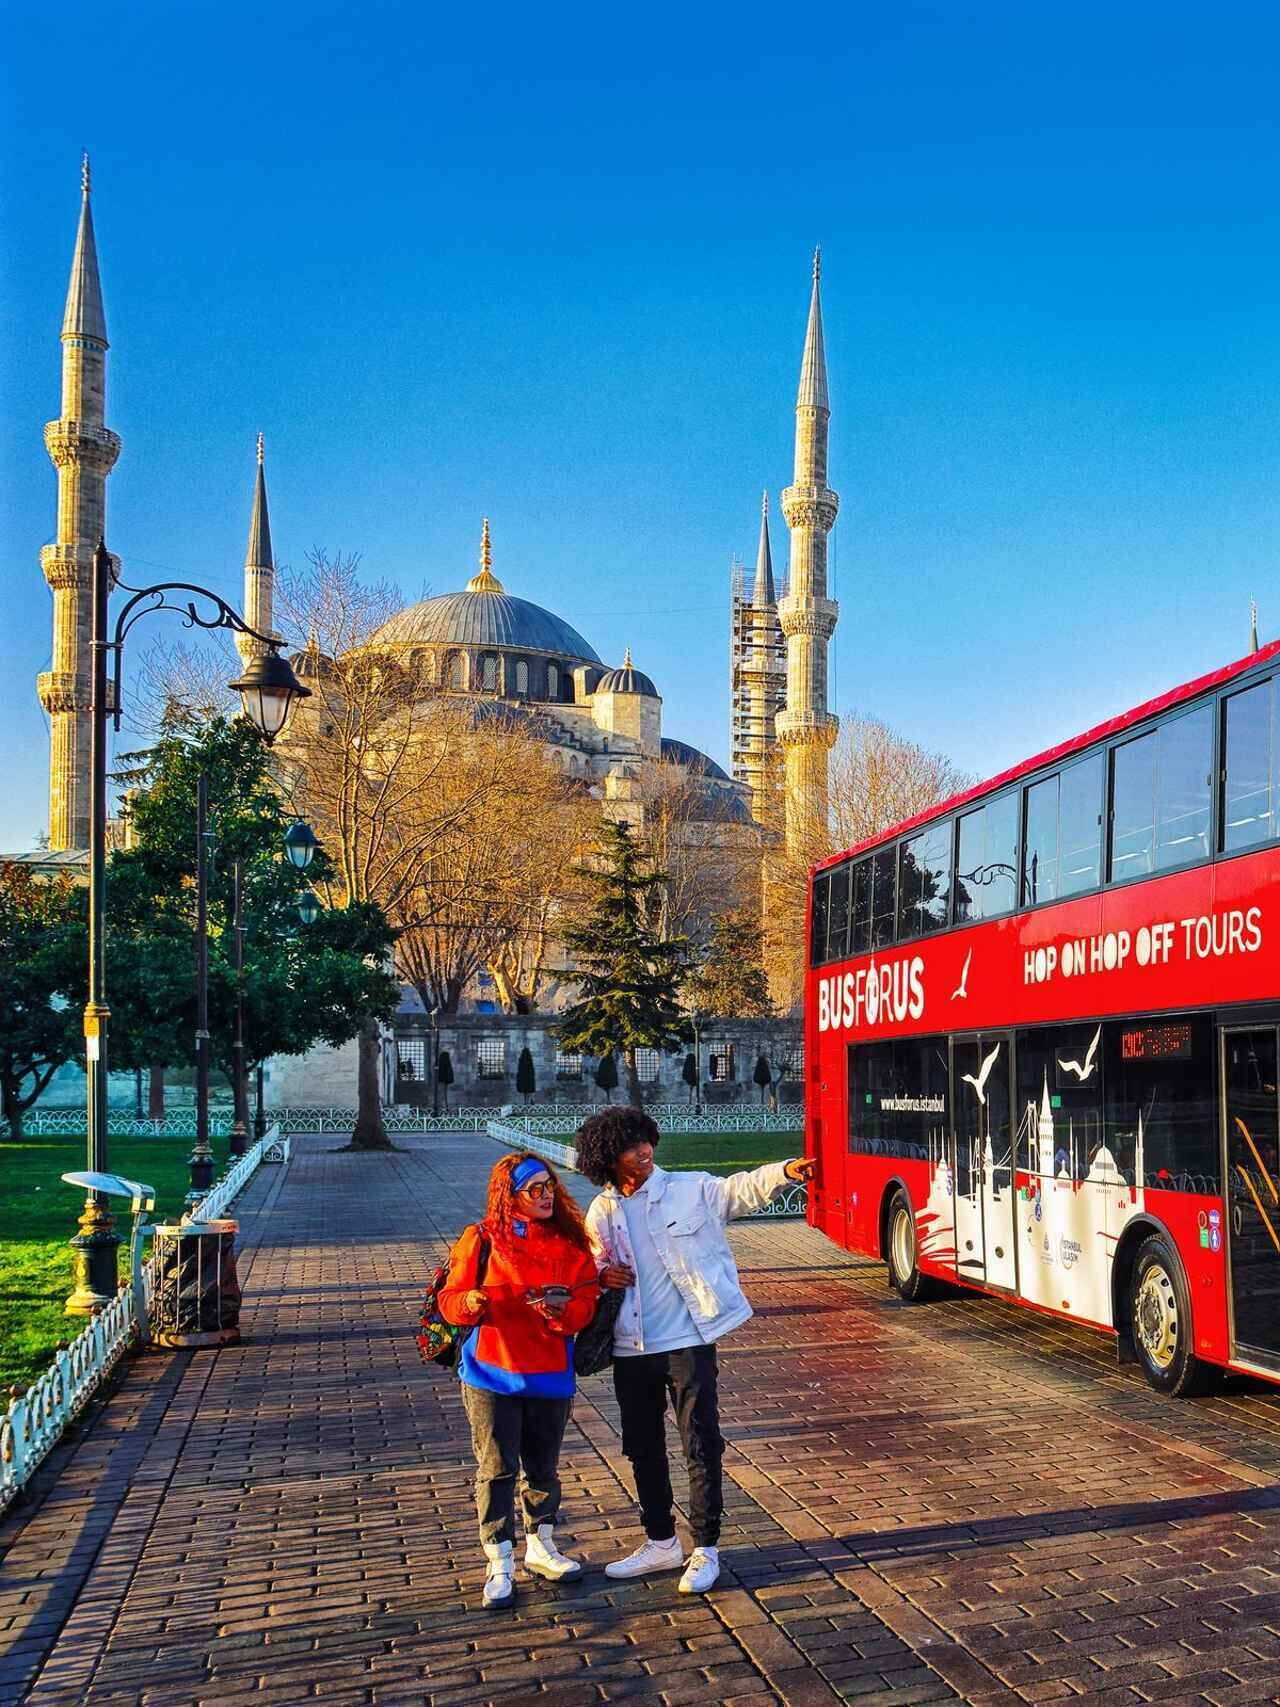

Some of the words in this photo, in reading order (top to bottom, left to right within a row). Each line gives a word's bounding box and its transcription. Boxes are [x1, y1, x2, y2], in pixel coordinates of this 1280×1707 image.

[1024, 946, 1057, 985] HOP
[1061, 939, 1086, 978] ON
[1091, 930, 1131, 973] HOP
[1136, 922, 1175, 967] OFF
[1181, 907, 1262, 960] TOURS
[818, 956, 925, 1032] BUSFORUS
[880, 1093, 945, 1112] www.busforus.istanbul
